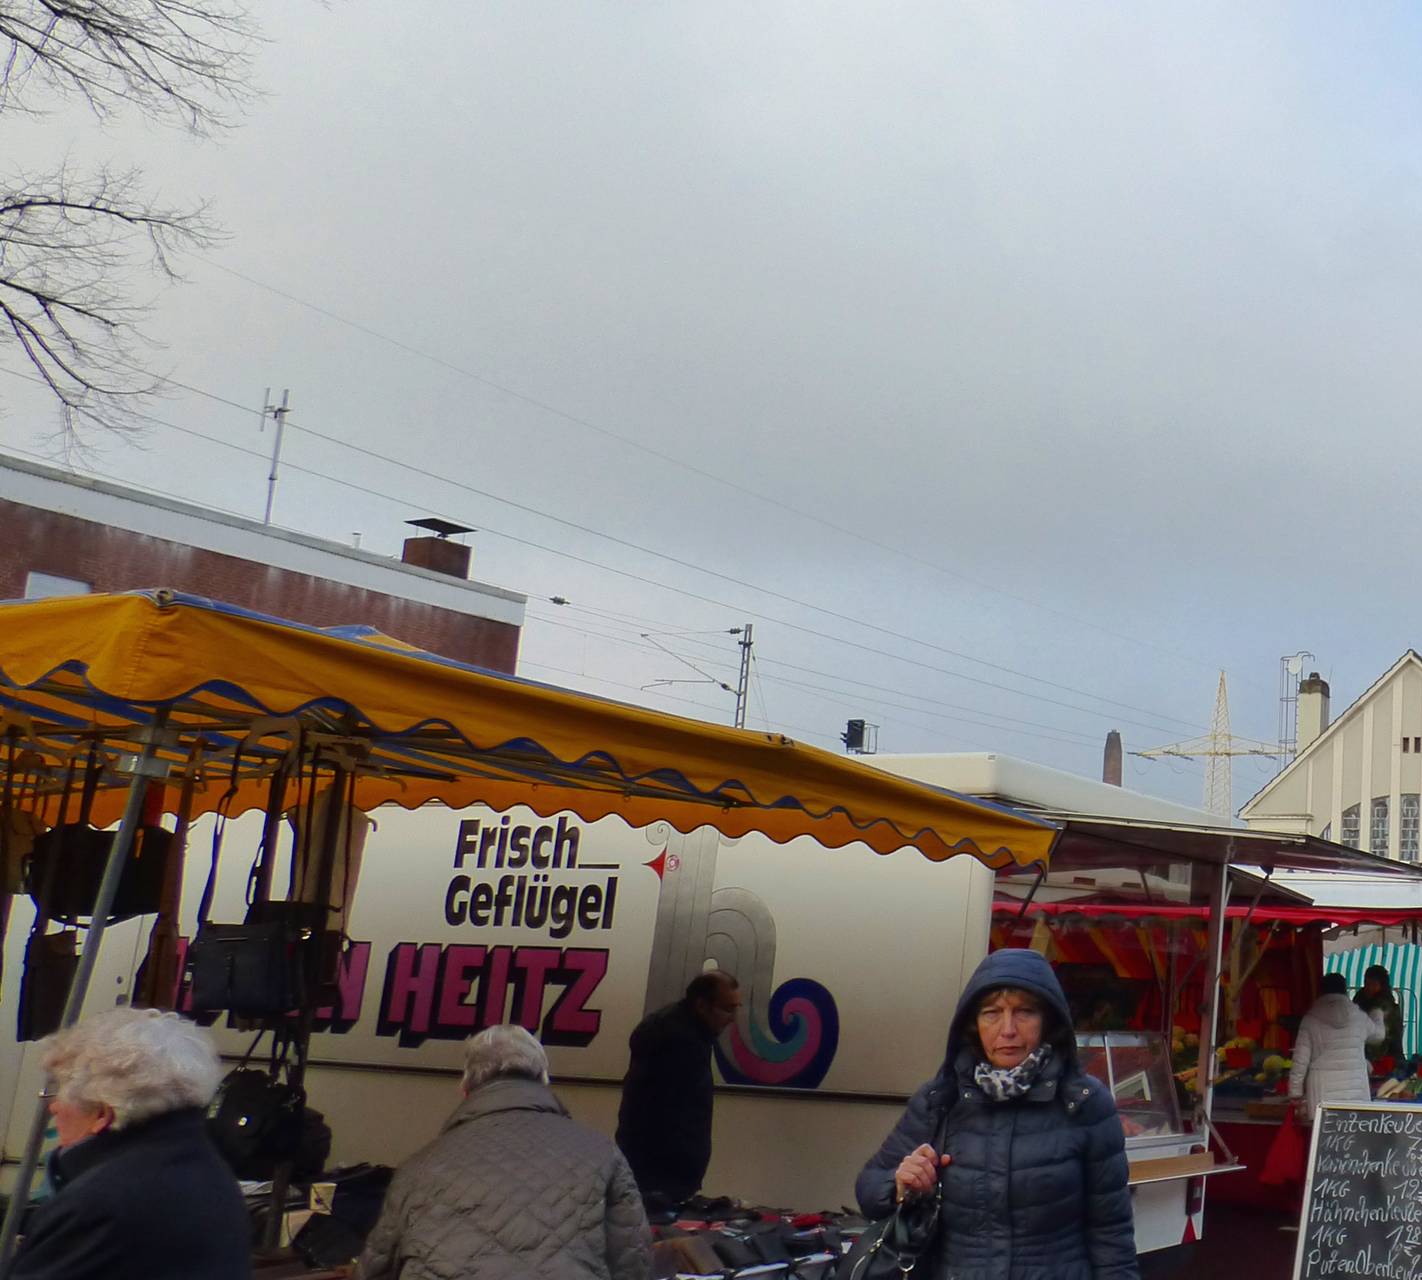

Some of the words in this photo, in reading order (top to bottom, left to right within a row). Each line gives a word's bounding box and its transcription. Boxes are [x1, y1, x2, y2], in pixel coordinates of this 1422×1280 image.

[453, 815, 581, 869] Frisch
[445, 873, 618, 939] Geflügel
[380, 942, 609, 1046] HEITZ
